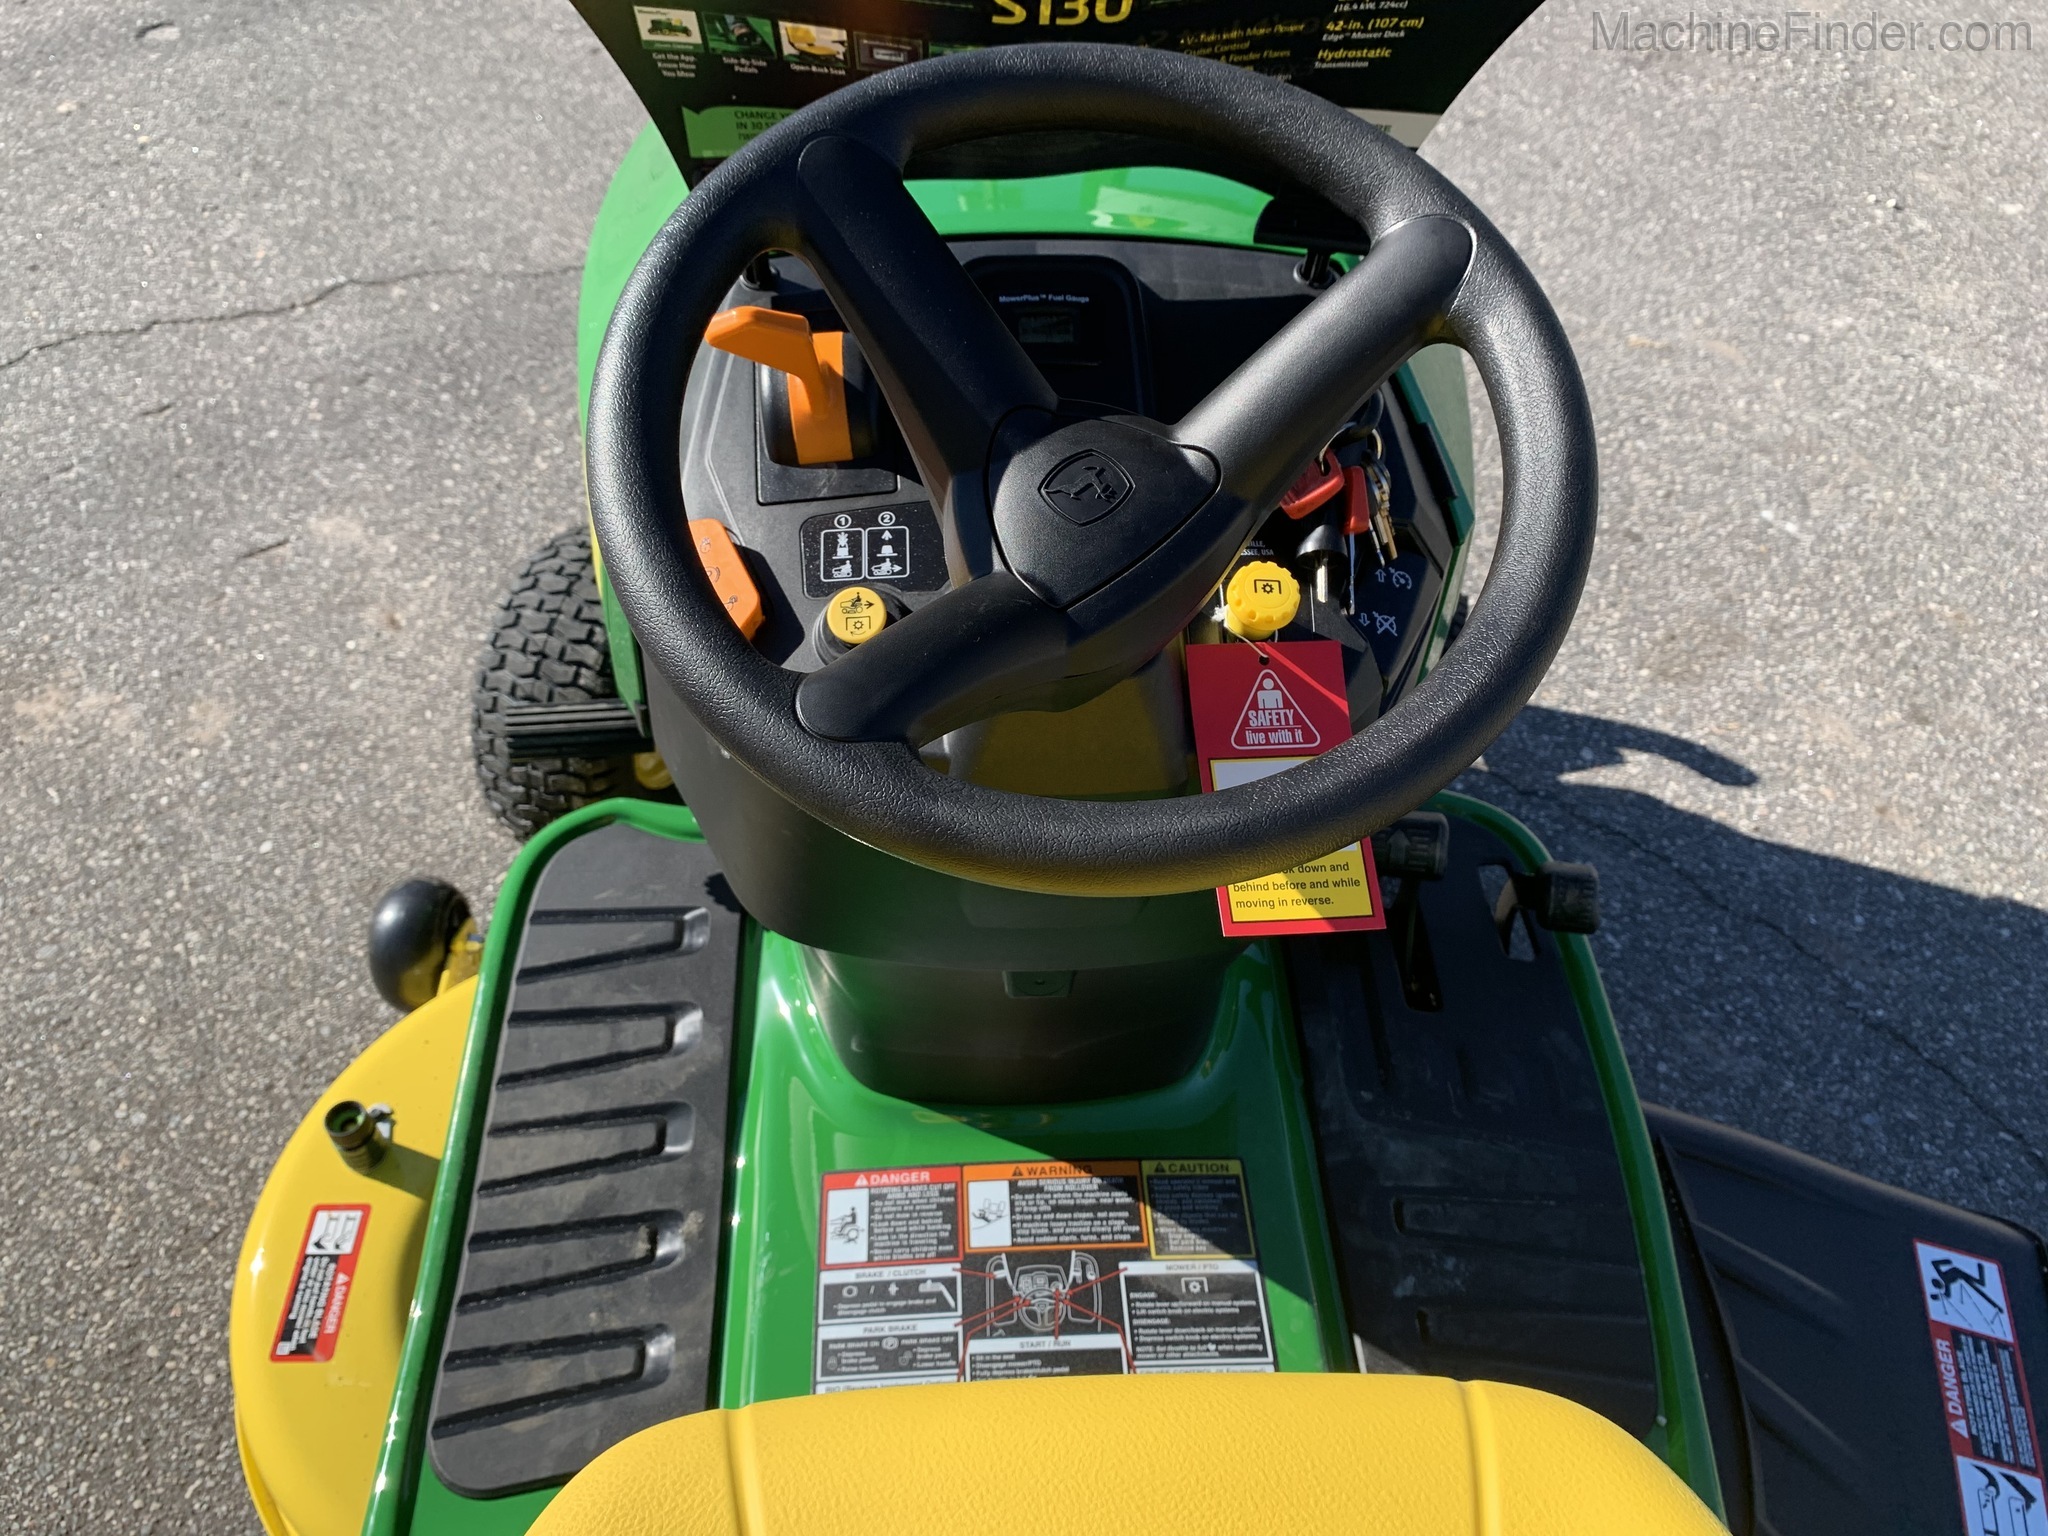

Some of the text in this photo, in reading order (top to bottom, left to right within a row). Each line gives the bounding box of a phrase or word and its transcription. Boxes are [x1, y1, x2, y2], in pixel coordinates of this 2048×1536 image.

[1326, 16, 1424, 31] 42-in. (107 cm)
[1318, 46, 1392, 61] Hydrostatic
[734, 110, 777, 120] CHANGE
[1066, 295, 1089, 303] Gauge
[1248, 709, 1295, 727] SAFETY
[1245, 728, 1303, 745] live with it
[1298, 864, 1326, 873] down
[1330, 862, 1350, 872] and
[1233, 878, 1360, 892] behind before and while
[1236, 896, 1334, 909] moving in reverse.
[1027, 1165, 1092, 1176] WARNING
[1168, 1163, 1229, 1173] CAUTION
[870, 1171, 931, 1185] DANGER
[322, 1284, 346, 1334] DANGER
[1020, 1340, 1045, 1348] START
[1934, 1337, 1963, 1416] DANGER
